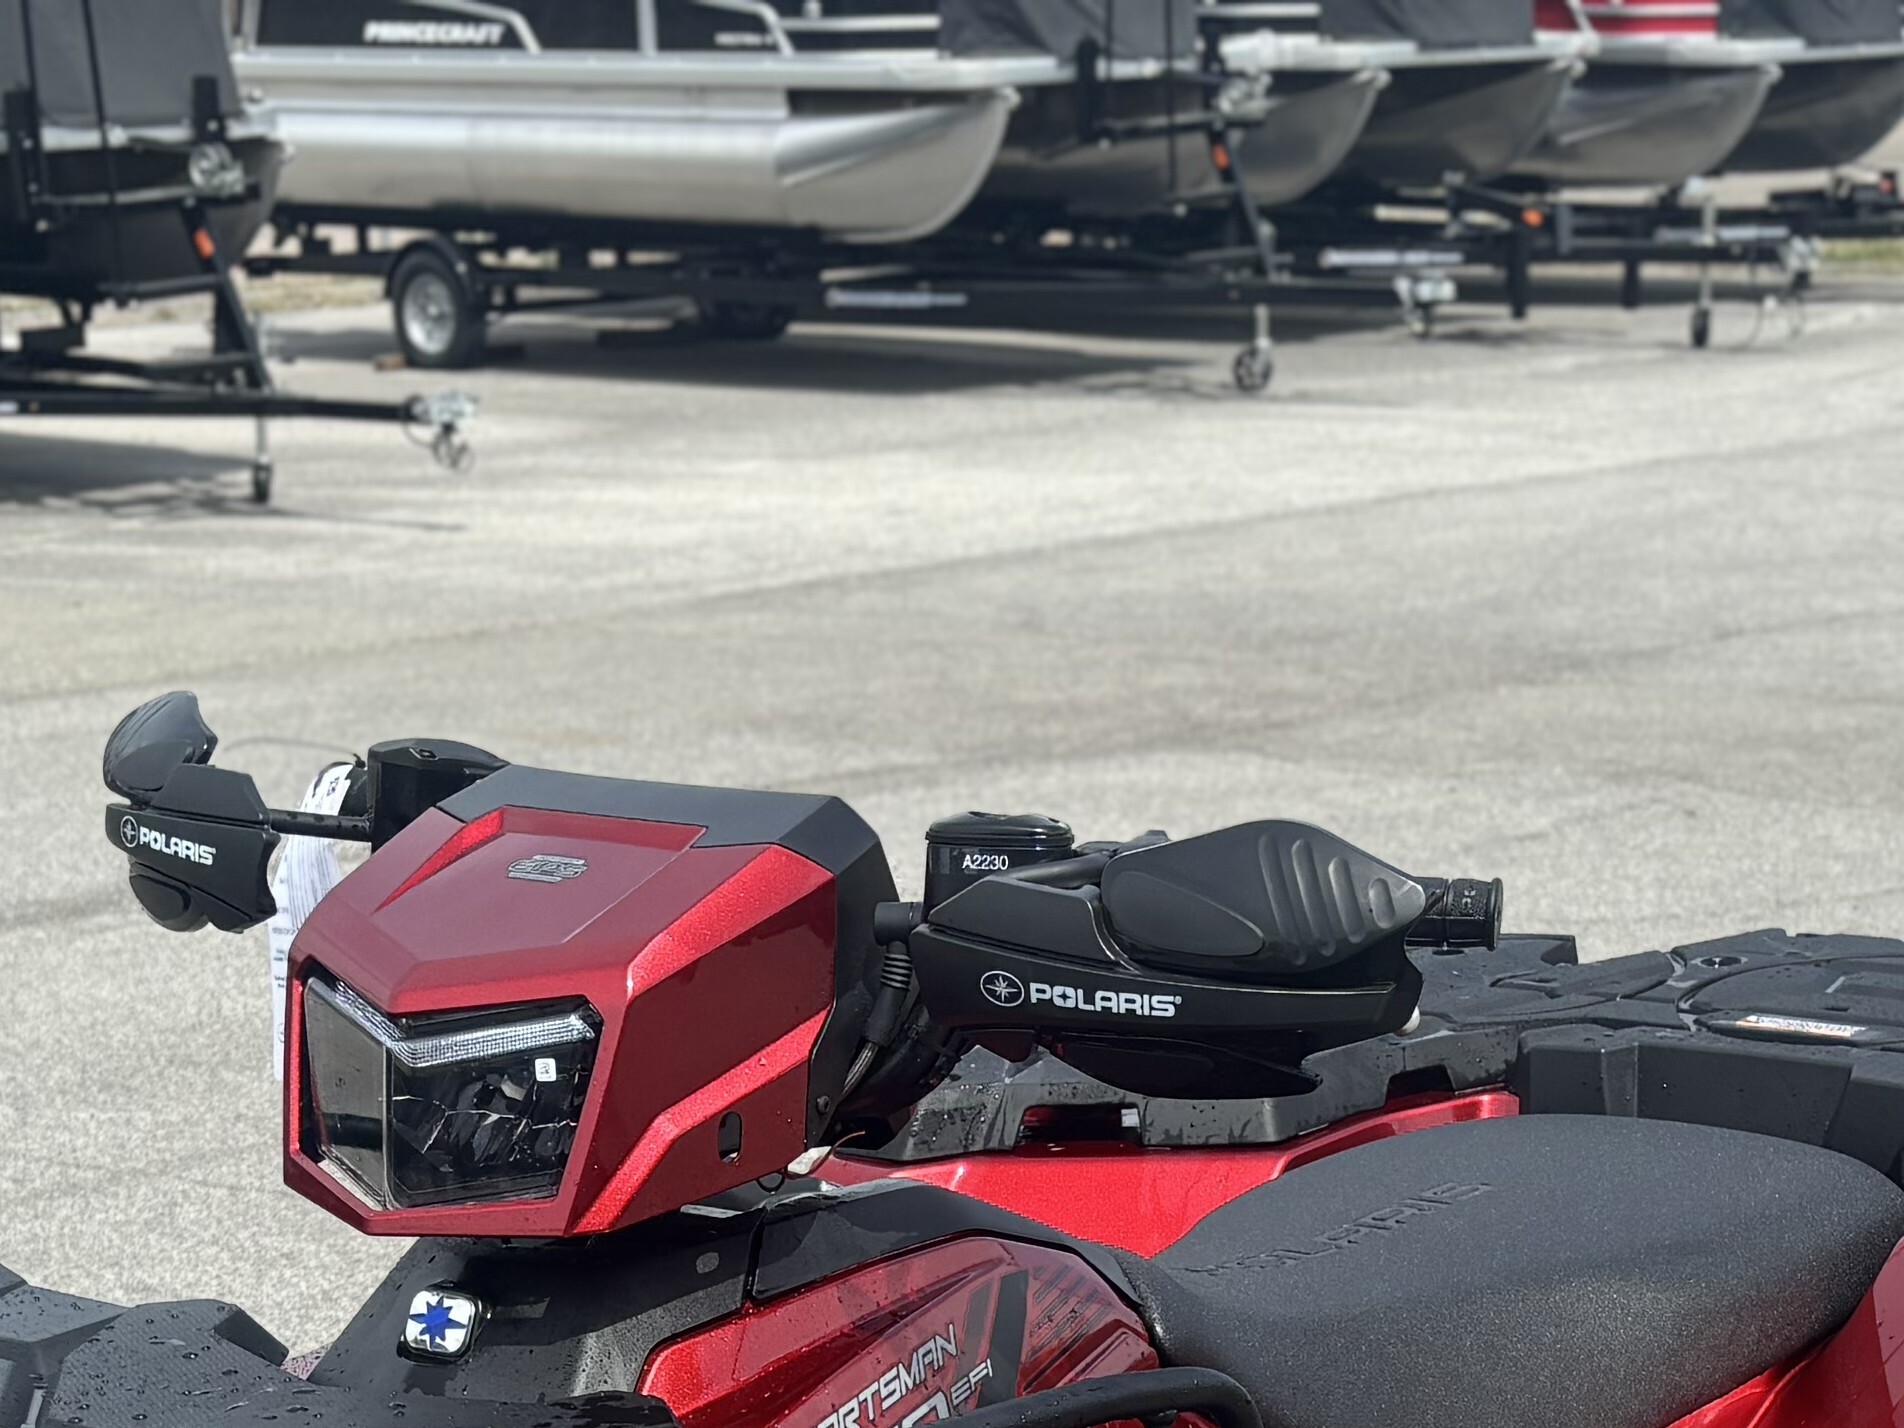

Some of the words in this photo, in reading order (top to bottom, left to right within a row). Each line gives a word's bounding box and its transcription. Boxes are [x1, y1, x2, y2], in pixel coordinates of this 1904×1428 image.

[363, 20, 506, 45] PRINCECRAFT
[139, 825, 216, 866] POLARIS
[962, 854, 1009, 870] A2230
[1029, 981, 1182, 1018] POLARIS
[950, 1358, 993, 1407] EFI
